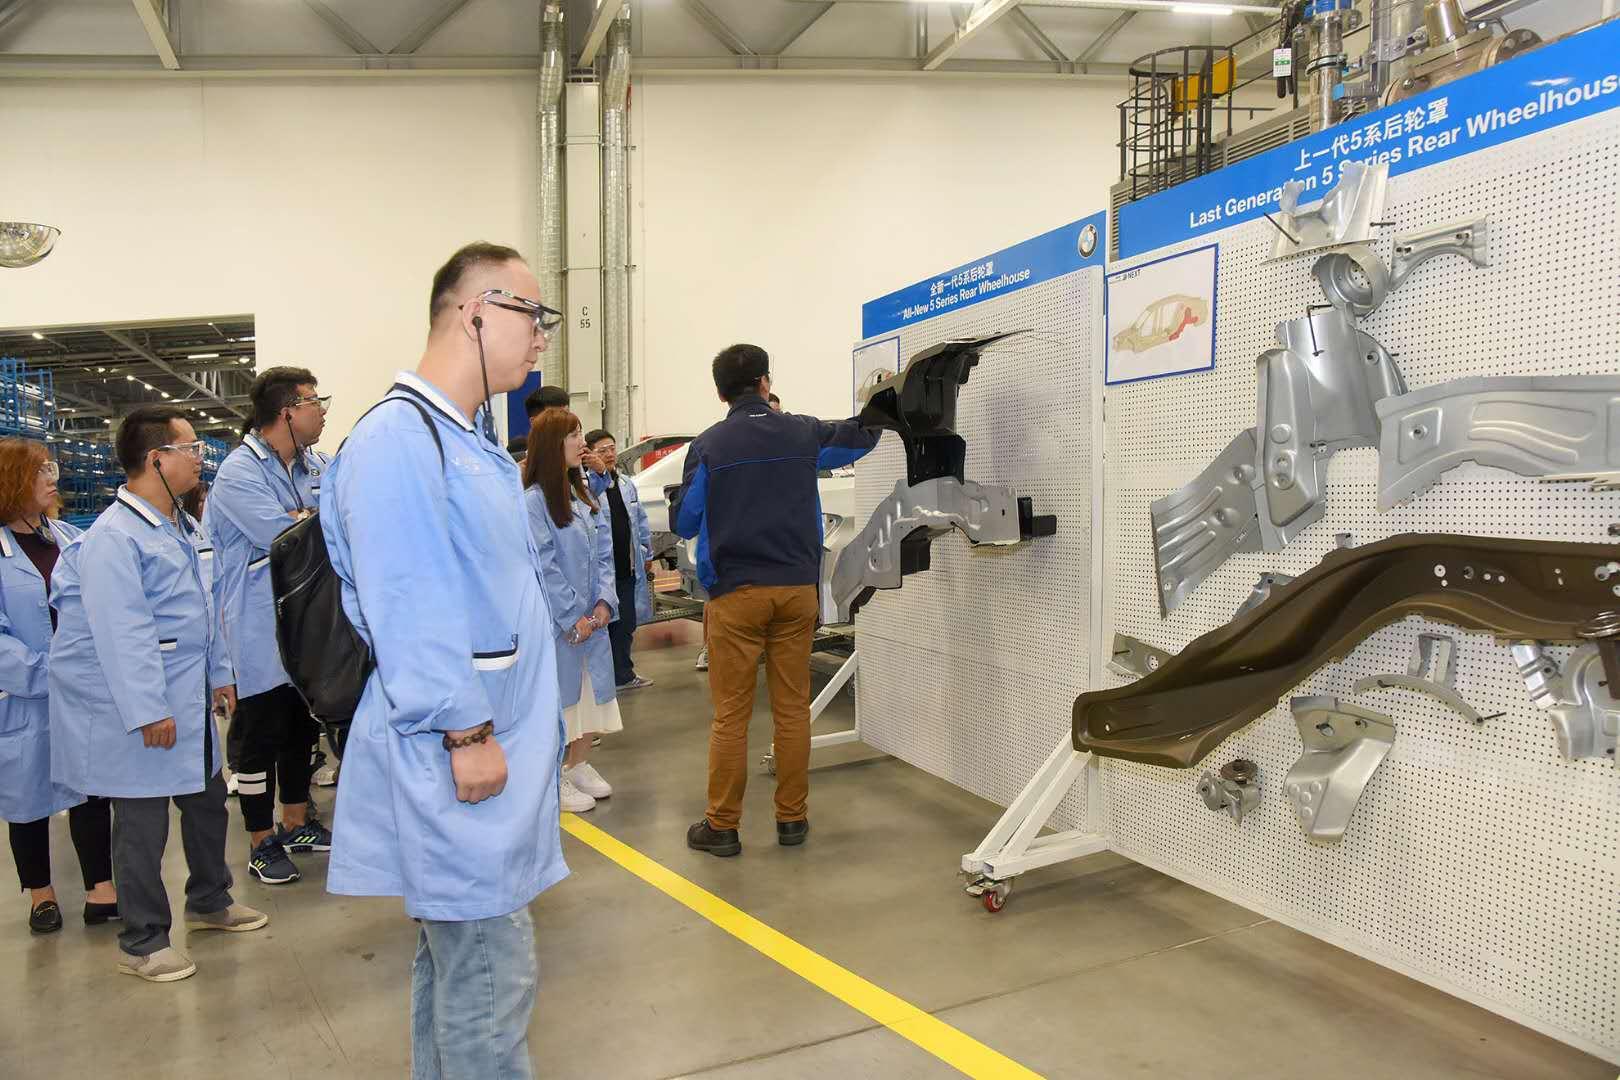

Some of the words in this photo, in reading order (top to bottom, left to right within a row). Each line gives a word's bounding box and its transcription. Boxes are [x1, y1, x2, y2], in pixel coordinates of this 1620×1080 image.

[1189, 204, 1221, 229] Last
[1225, 176, 1317, 217] Generaon
[1321, 165, 1334, 185] 5
[1407, 126, 1462, 158] Rear
[1466, 74, 1620, 138] Wheelhous
[1294, 97, 1449, 171] 上一代5系后轮罩
[582, 305, 588, 316] C
[903, 303, 929, 320] All-New
[929, 299, 936, 312] 5
[935, 293, 959, 309] Series
[960, 287, 978, 301] Rear
[978, 268, 1031, 295] Wheelhouse
[580, 318, 591, 329] 55
